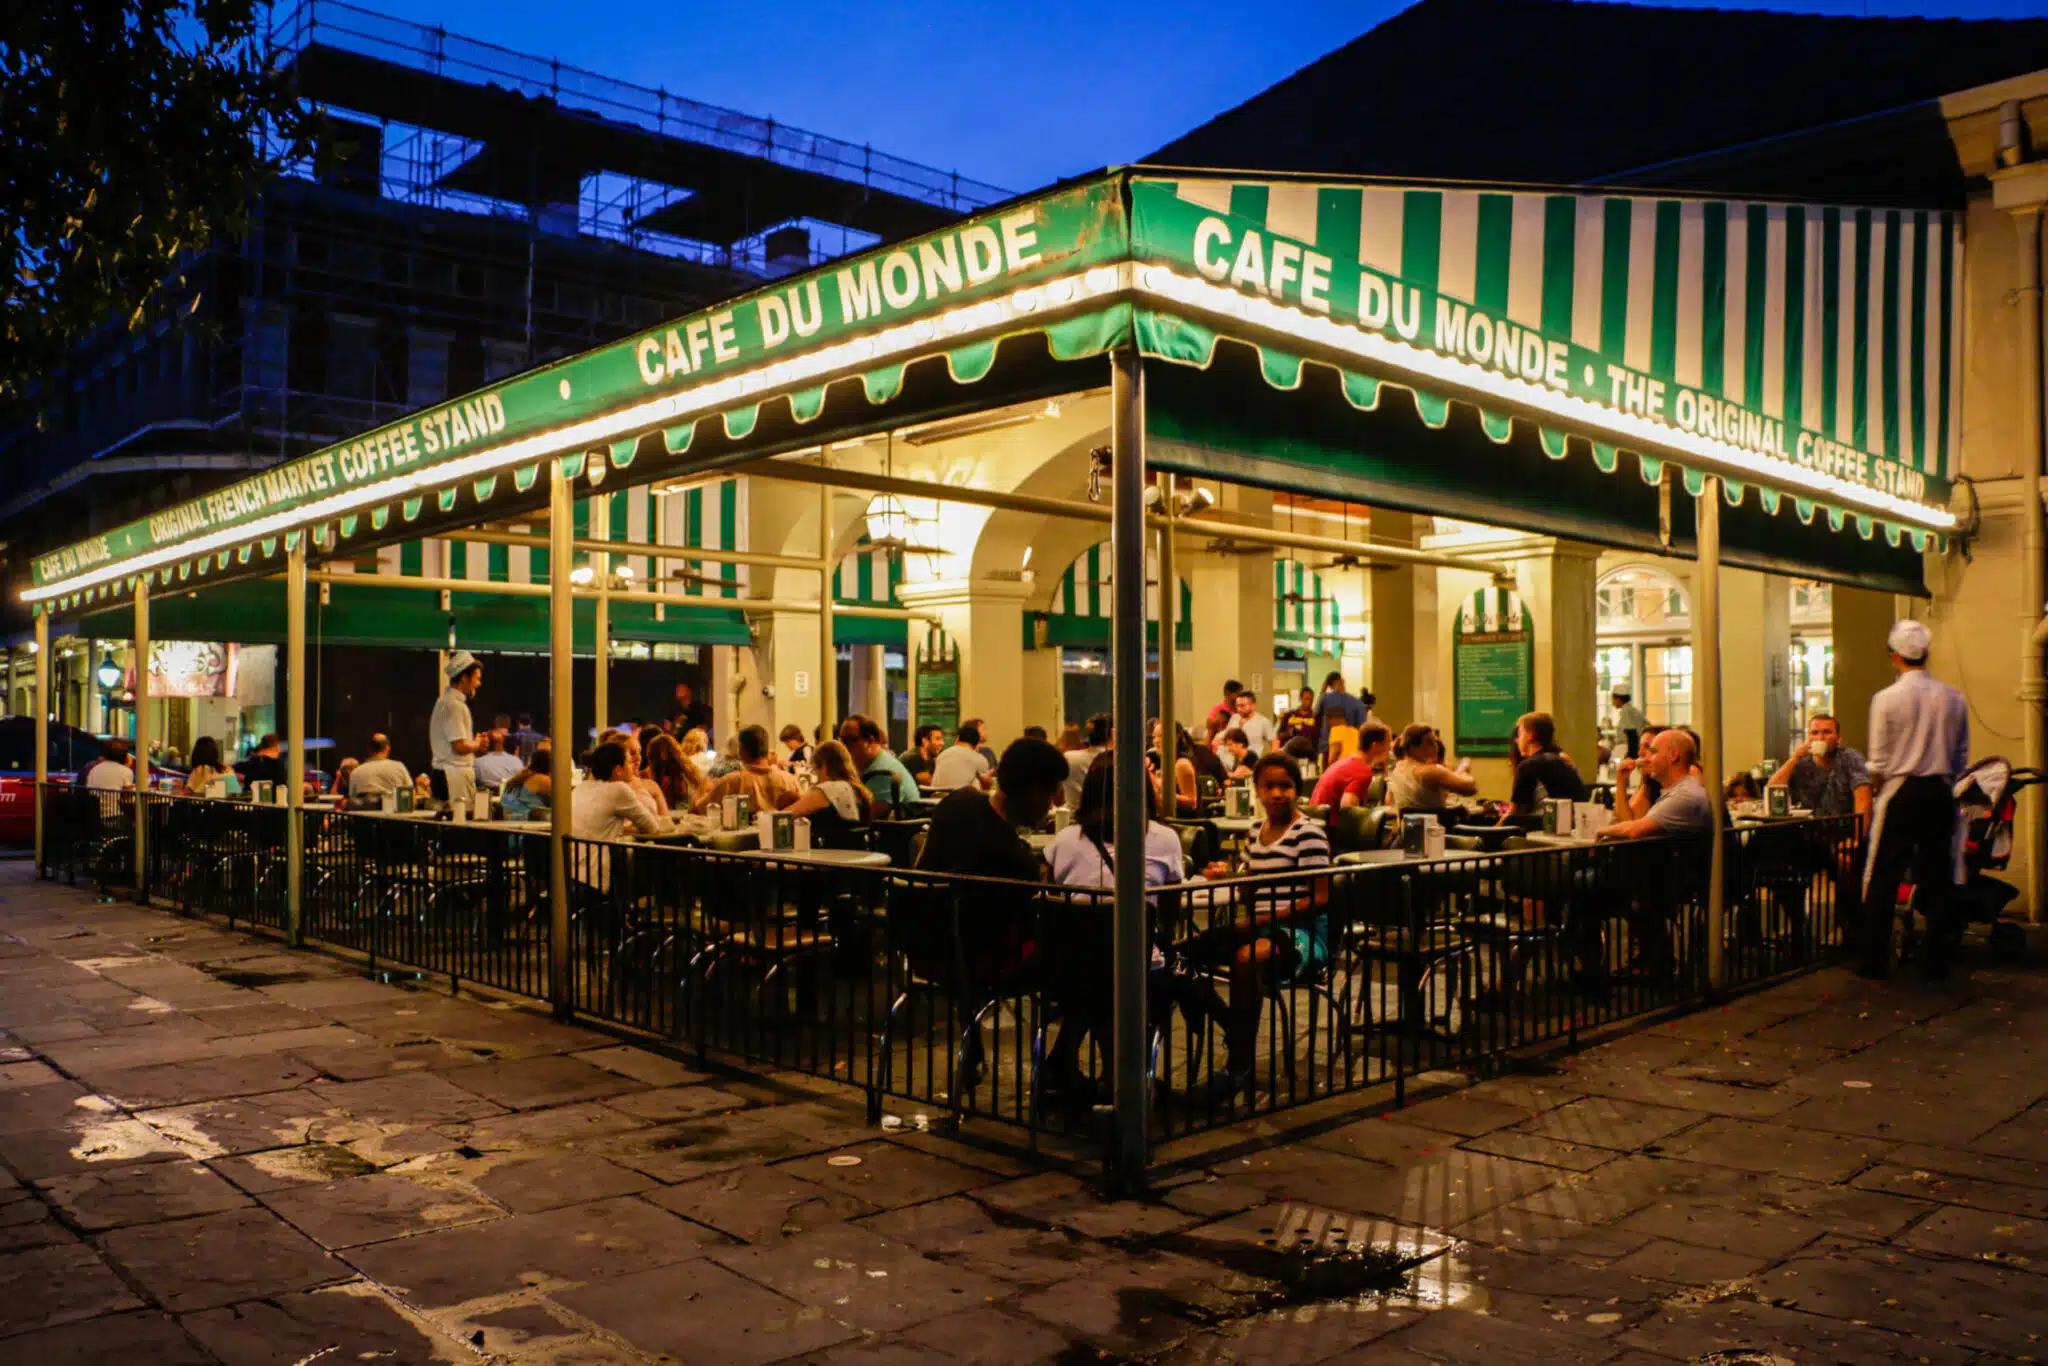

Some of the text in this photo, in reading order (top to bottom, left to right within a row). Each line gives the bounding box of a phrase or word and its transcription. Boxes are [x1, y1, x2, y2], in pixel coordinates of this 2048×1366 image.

[40, 209, 1042, 581] CAFE DU MONDE ORIGINAL FRENCH MARKET COFFEE STAND CAFE DU MONDE
[1193, 217, 1925, 501] CAFE DU MONDE THE ORIGINAL COFFEE STAND
